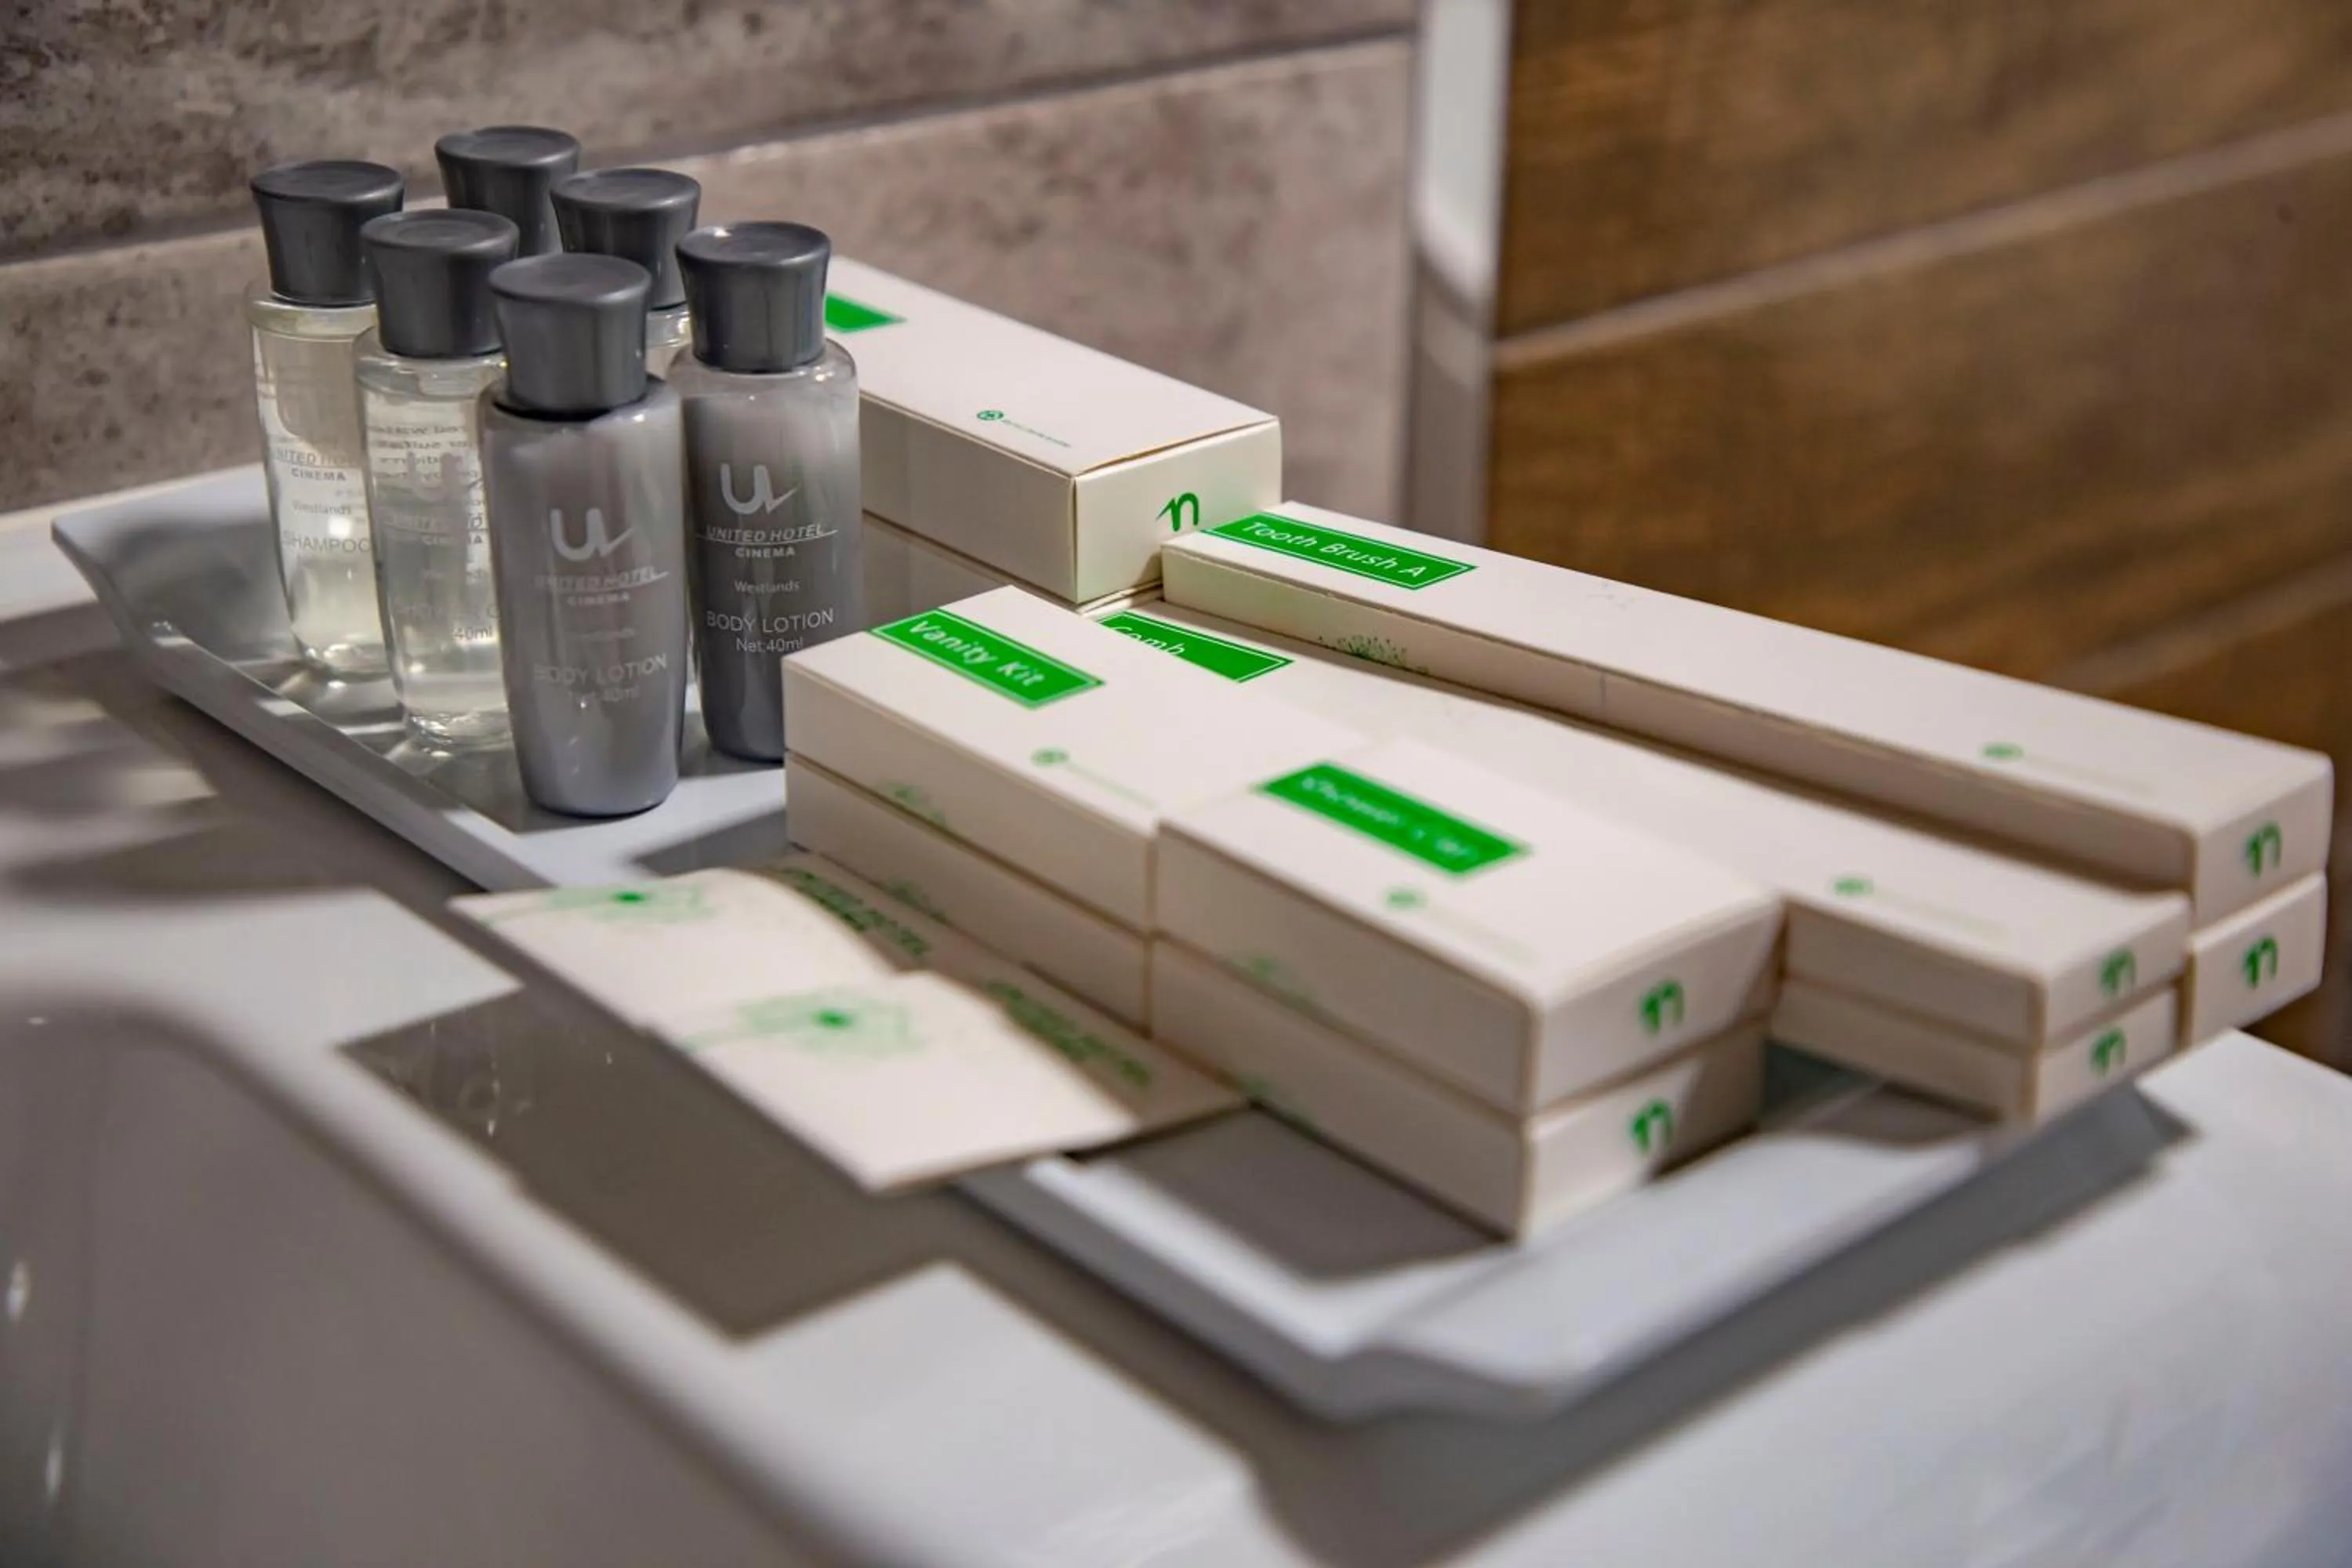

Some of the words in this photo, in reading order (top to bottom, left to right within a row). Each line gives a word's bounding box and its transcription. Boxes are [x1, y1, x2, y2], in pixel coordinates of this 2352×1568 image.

[291, 466, 347, 481] CINEMA
[706, 524, 765, 543] UNITED
[770, 523, 823, 542] HOTEL
[734, 546, 796, 559] CINEMA
[1242, 521, 1318, 548] Tooth
[1319, 543, 1399, 570] Brush
[1398, 564, 1428, 579] A
[734, 579, 801, 594] Westlands
[706, 610, 757, 632] BODY
[761, 608, 835, 633] LOTION
[909, 619, 1000, 665] Vanity
[995, 660, 1047, 688] Kit
[595, 652, 668, 687] LOTION
